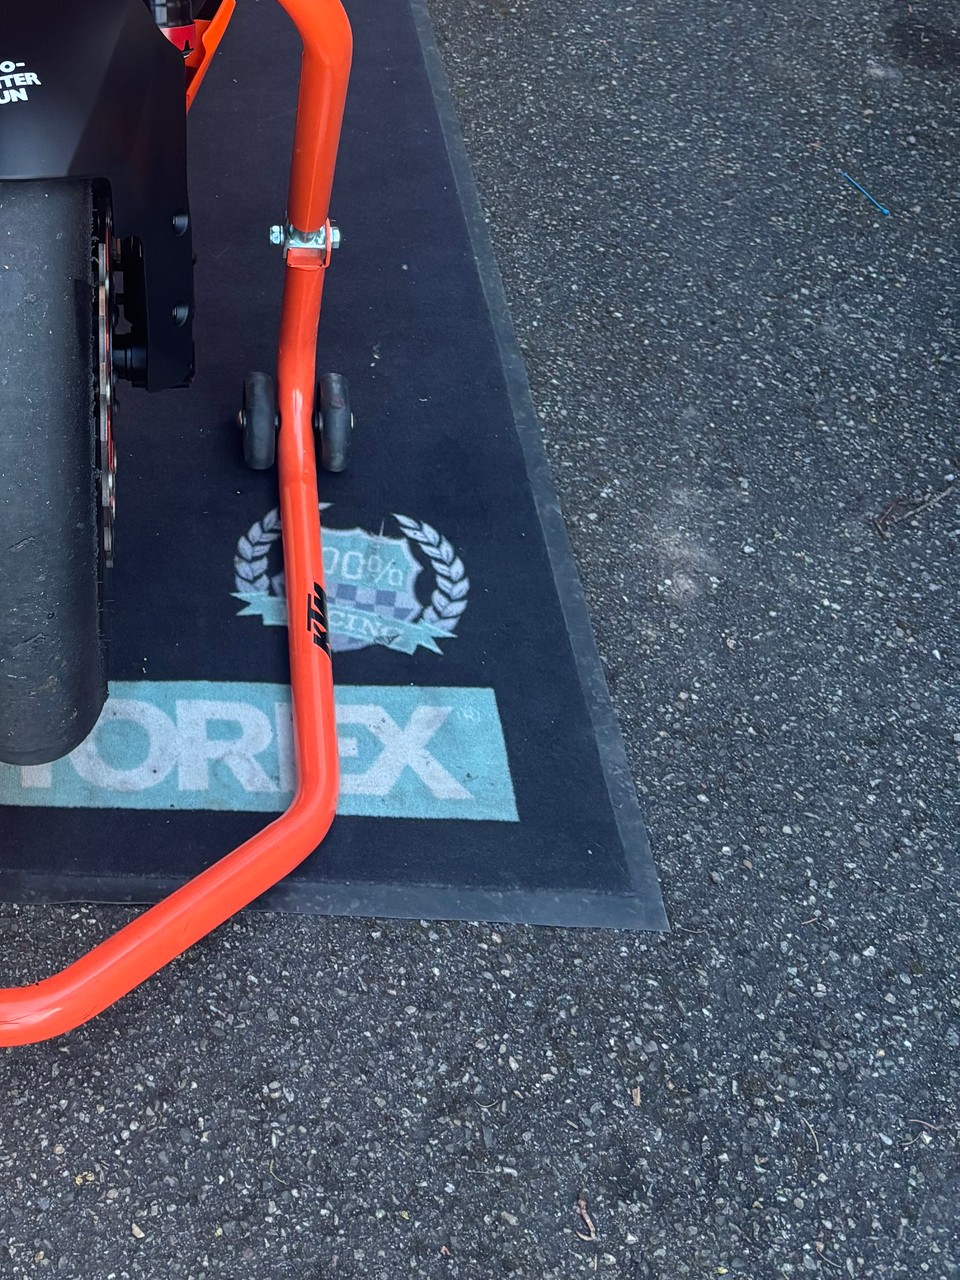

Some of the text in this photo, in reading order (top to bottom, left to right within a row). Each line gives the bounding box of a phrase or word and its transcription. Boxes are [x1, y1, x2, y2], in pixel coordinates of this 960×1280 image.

[322, 546, 404, 586] 00%
[307, 582, 332, 660] KTM
[329, 610, 403, 640] CING
